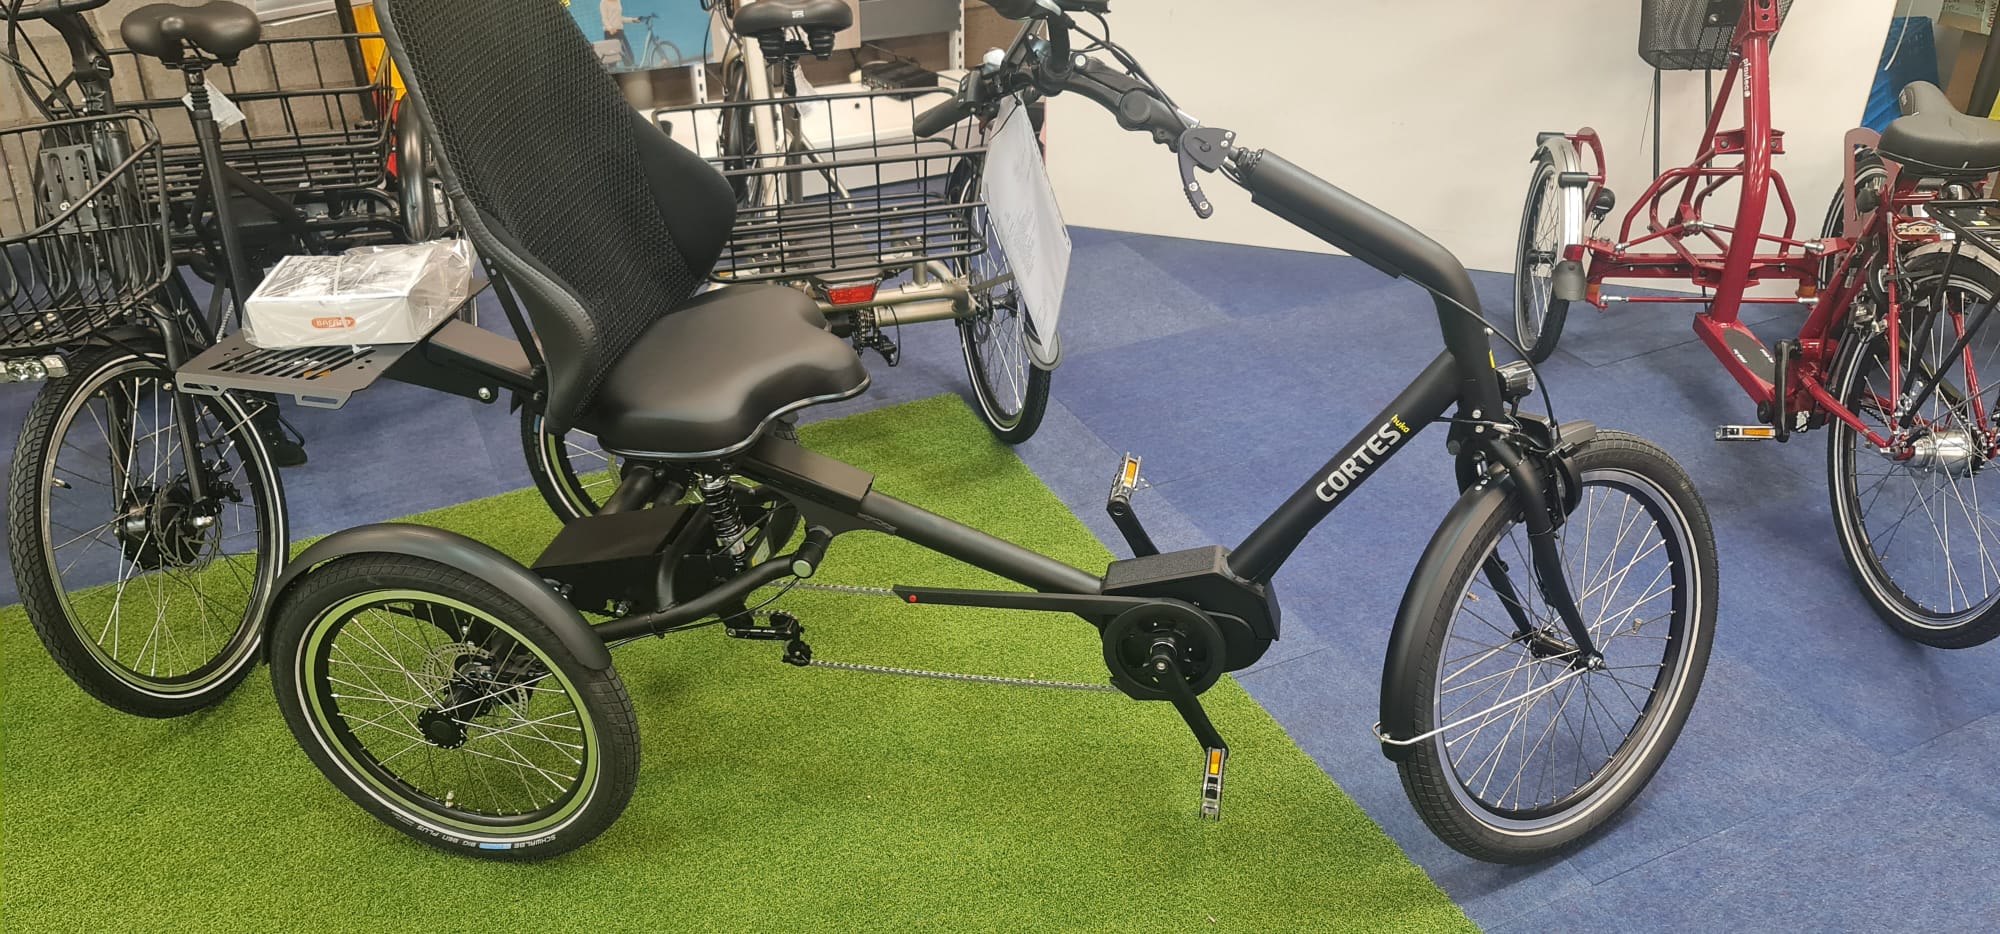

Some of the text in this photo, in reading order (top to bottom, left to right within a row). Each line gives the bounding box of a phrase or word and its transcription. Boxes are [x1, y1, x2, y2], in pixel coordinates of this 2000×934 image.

[180, 297, 207, 346] VOG
[1391, 415, 1410, 433] huka
[1316, 423, 1401, 502] CORTES
[416, 825, 439, 837] PLUS
[462, 840, 477, 848] BIG
[513, 835, 556, 848] SCHWALBE
